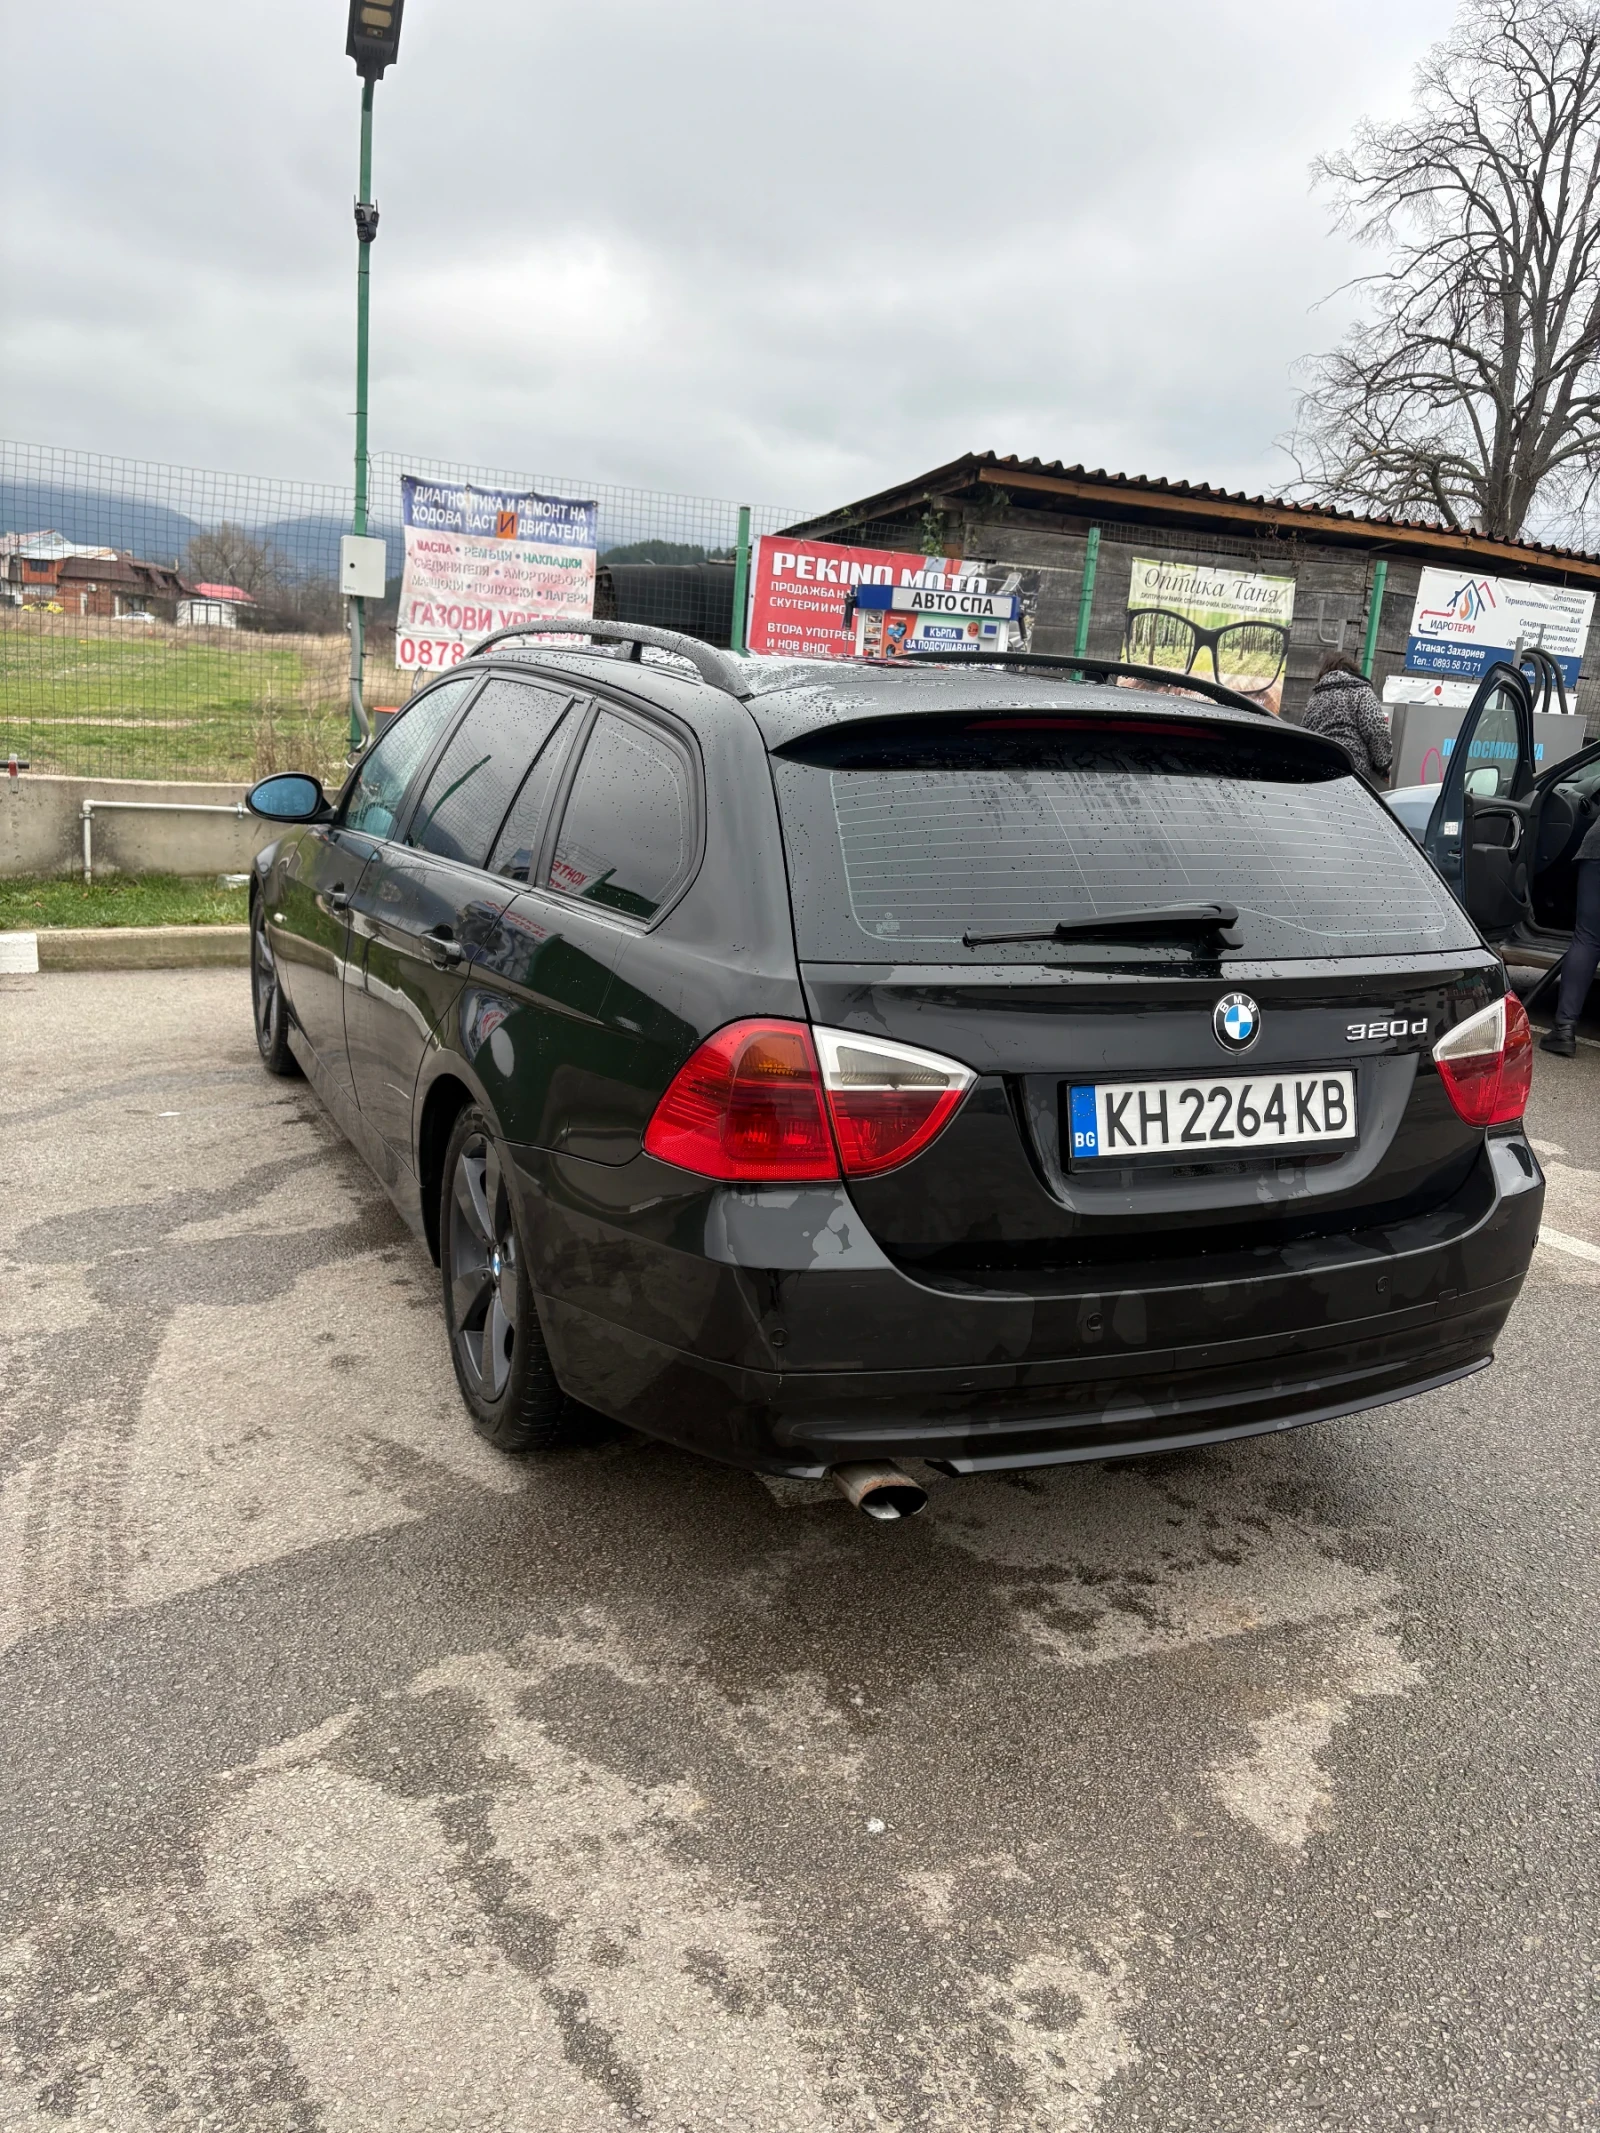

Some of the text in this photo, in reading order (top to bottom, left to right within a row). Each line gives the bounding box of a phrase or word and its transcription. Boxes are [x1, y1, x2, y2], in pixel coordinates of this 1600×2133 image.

[414, 486, 586, 522] ДИАГНОТИКА И РЕМОНТ НА
[412, 505, 462, 526] ХОДОВА
[466, 513, 497, 531] ЧАСТ
[517, 519, 588, 542] ДВИГАТЕЛИ
[523, 552, 582, 570] НАКЛАДКИ
[772, 552, 988, 594] PEKINO MOTO
[771, 581, 835, 598] ПРОДАЖБА
[1144, 568, 1282, 604] Оптика Таня
[769, 597, 819, 612] СКУТЕРИ
[821, 604, 828, 612] И
[911, 592, 994, 615] АВТО СПА
[1505, 596, 1548, 610] Термопомпени
[409, 601, 492, 632] ГАЗОВИ
[1519, 618, 1541, 629] Соларн
[767, 622, 857, 641] ВТОРА УПОТРЕБ
[929, 627, 957, 638] КЪРПА
[1430, 619, 1475, 634] ИДРОТЕРМ
[1521, 630, 1557, 641] Хидроорни
[400, 638, 466, 666] 0878
[766, 638, 832, 654] И НОВ ВНОС
[905, 639, 916, 649] ЗА
[1415, 641, 1486, 660] Атанас Захариев
[1432, 657, 1451, 669] 0893
[1451, 660, 1461, 670] 58
[1462, 661, 1471, 671] 73
[1472, 663, 1482, 672] 71
[1219, 995, 1257, 1014] BMW
[1345, 1017, 1429, 1042] 320d
[1074, 1132, 1096, 1148] BG
